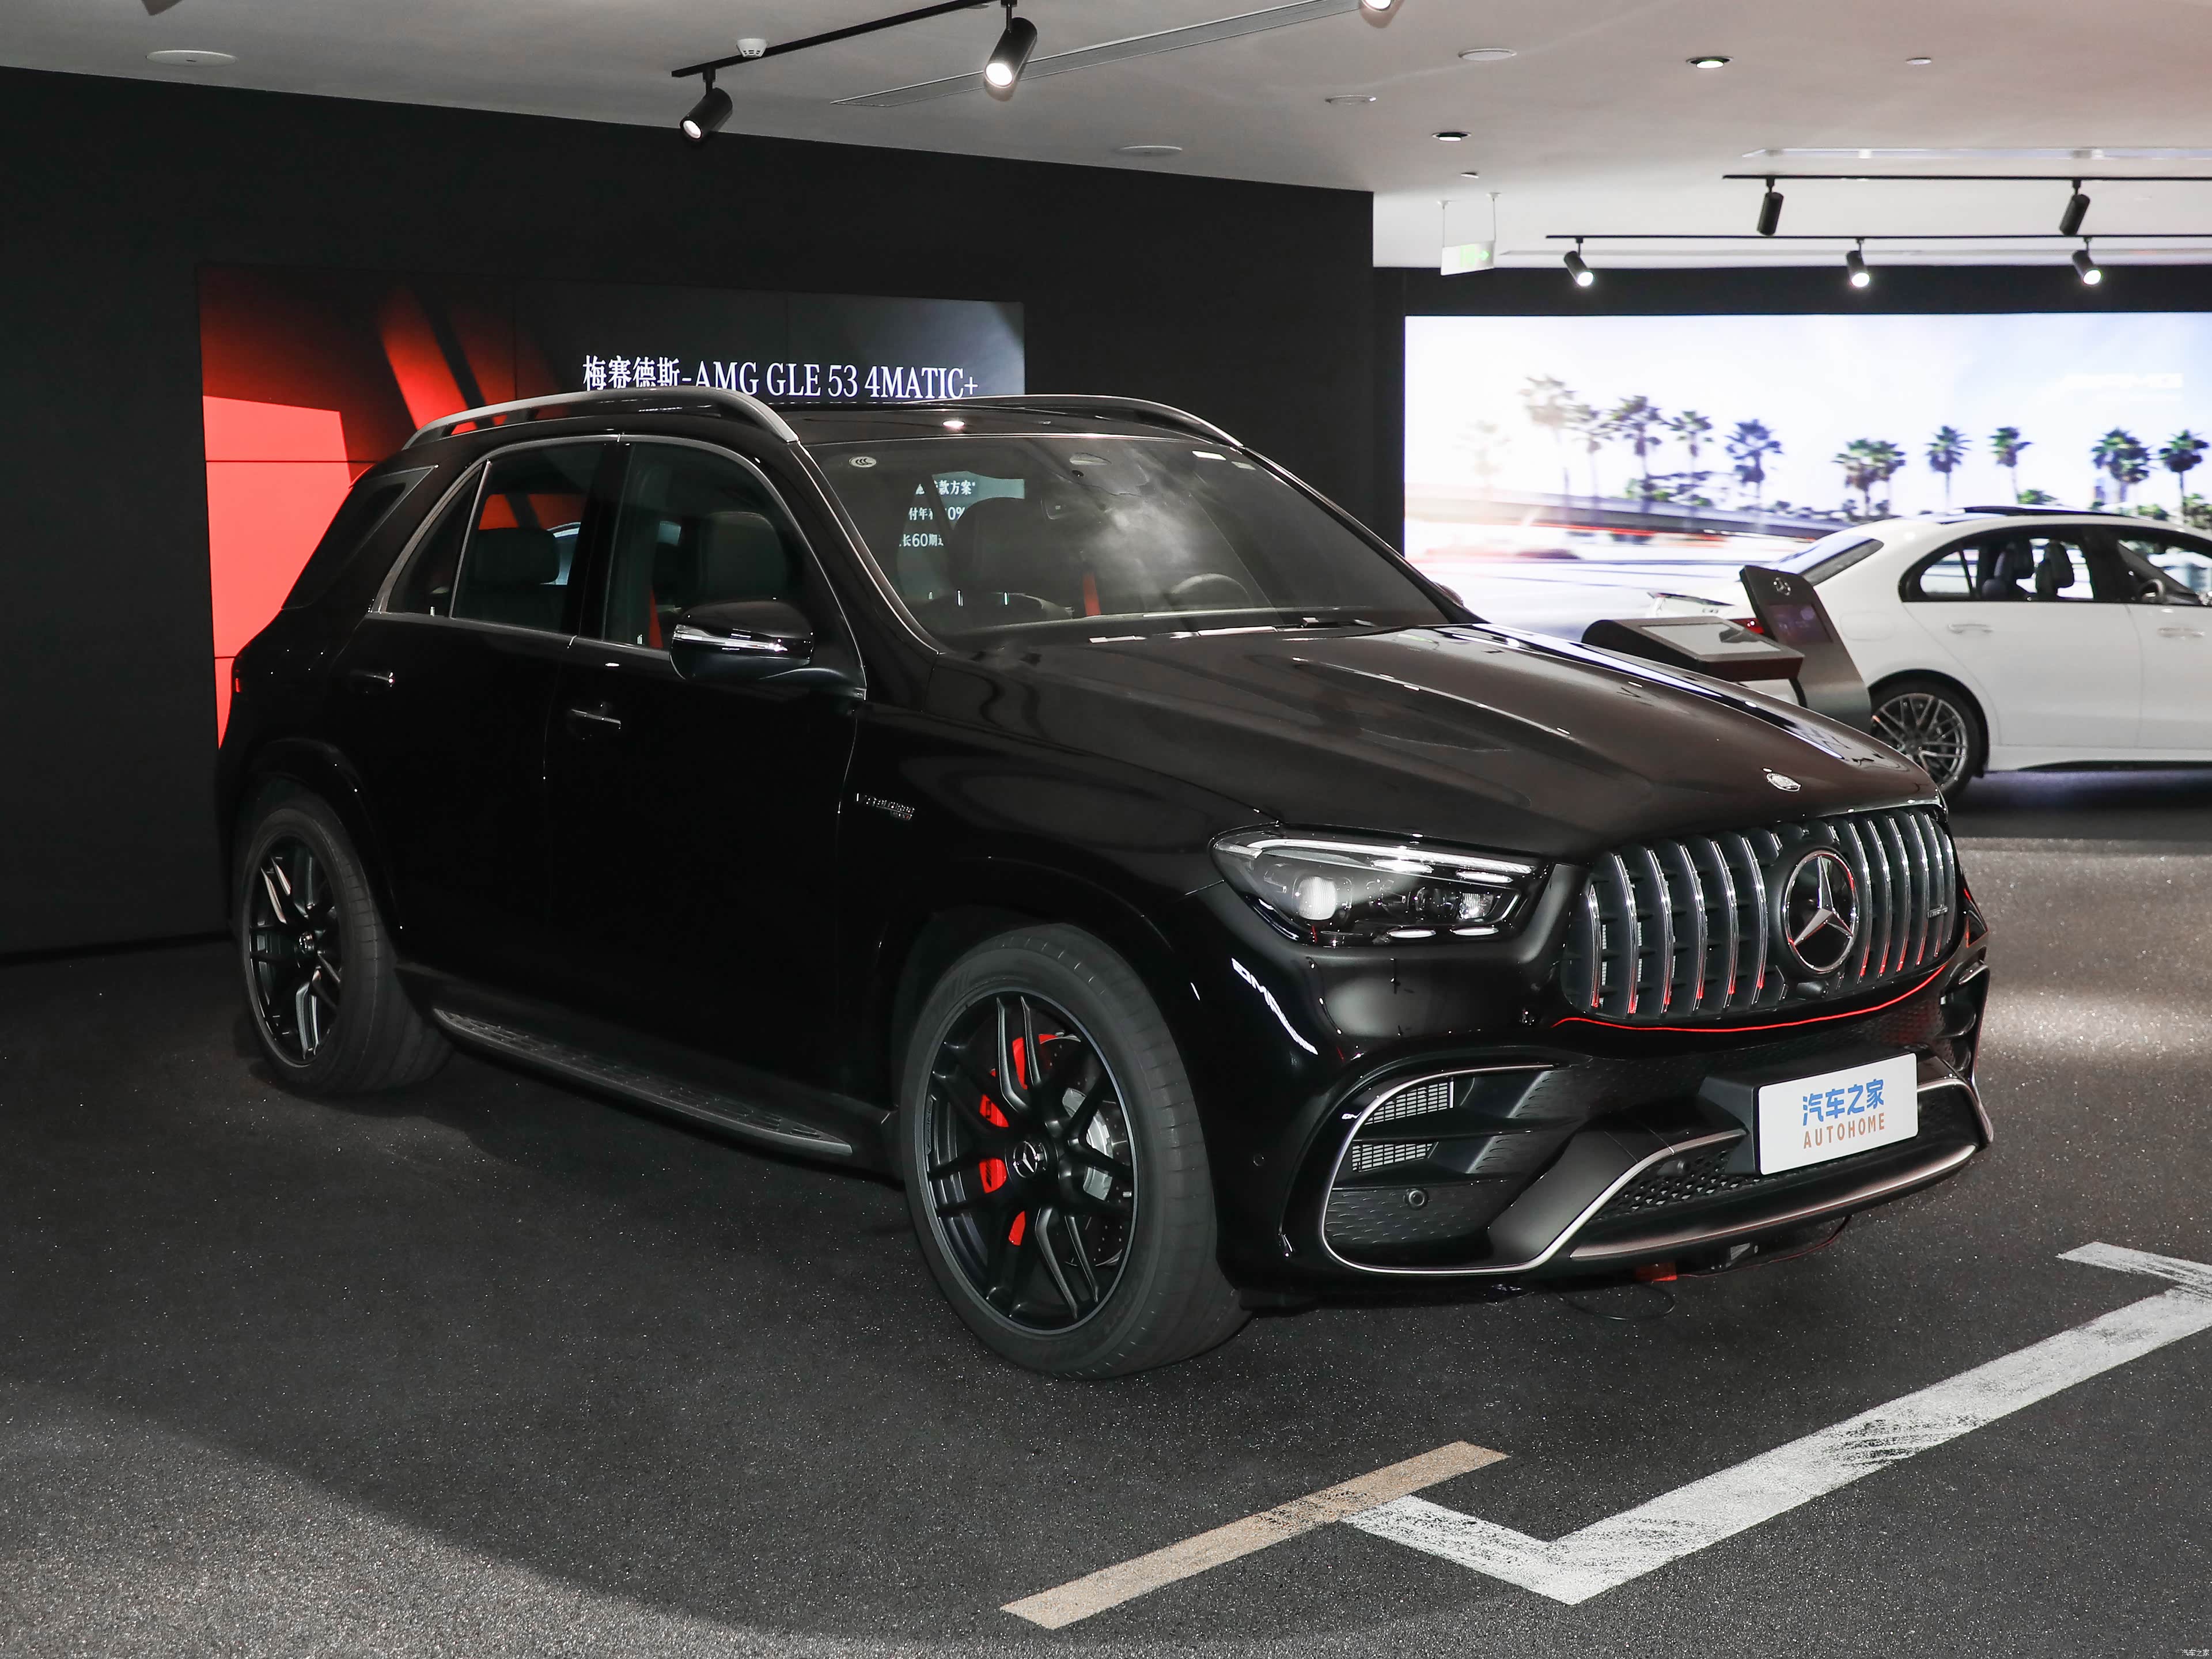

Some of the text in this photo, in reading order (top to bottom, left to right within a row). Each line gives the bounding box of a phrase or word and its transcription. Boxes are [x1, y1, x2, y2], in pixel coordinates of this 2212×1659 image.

[582, 354, 978, 399] 梅赛德斯-AMG GLE 53 4MATIC+
[1803, 1078, 1884, 1126] 汽车之家
[1804, 1112, 1885, 1149] AUTOHOME
